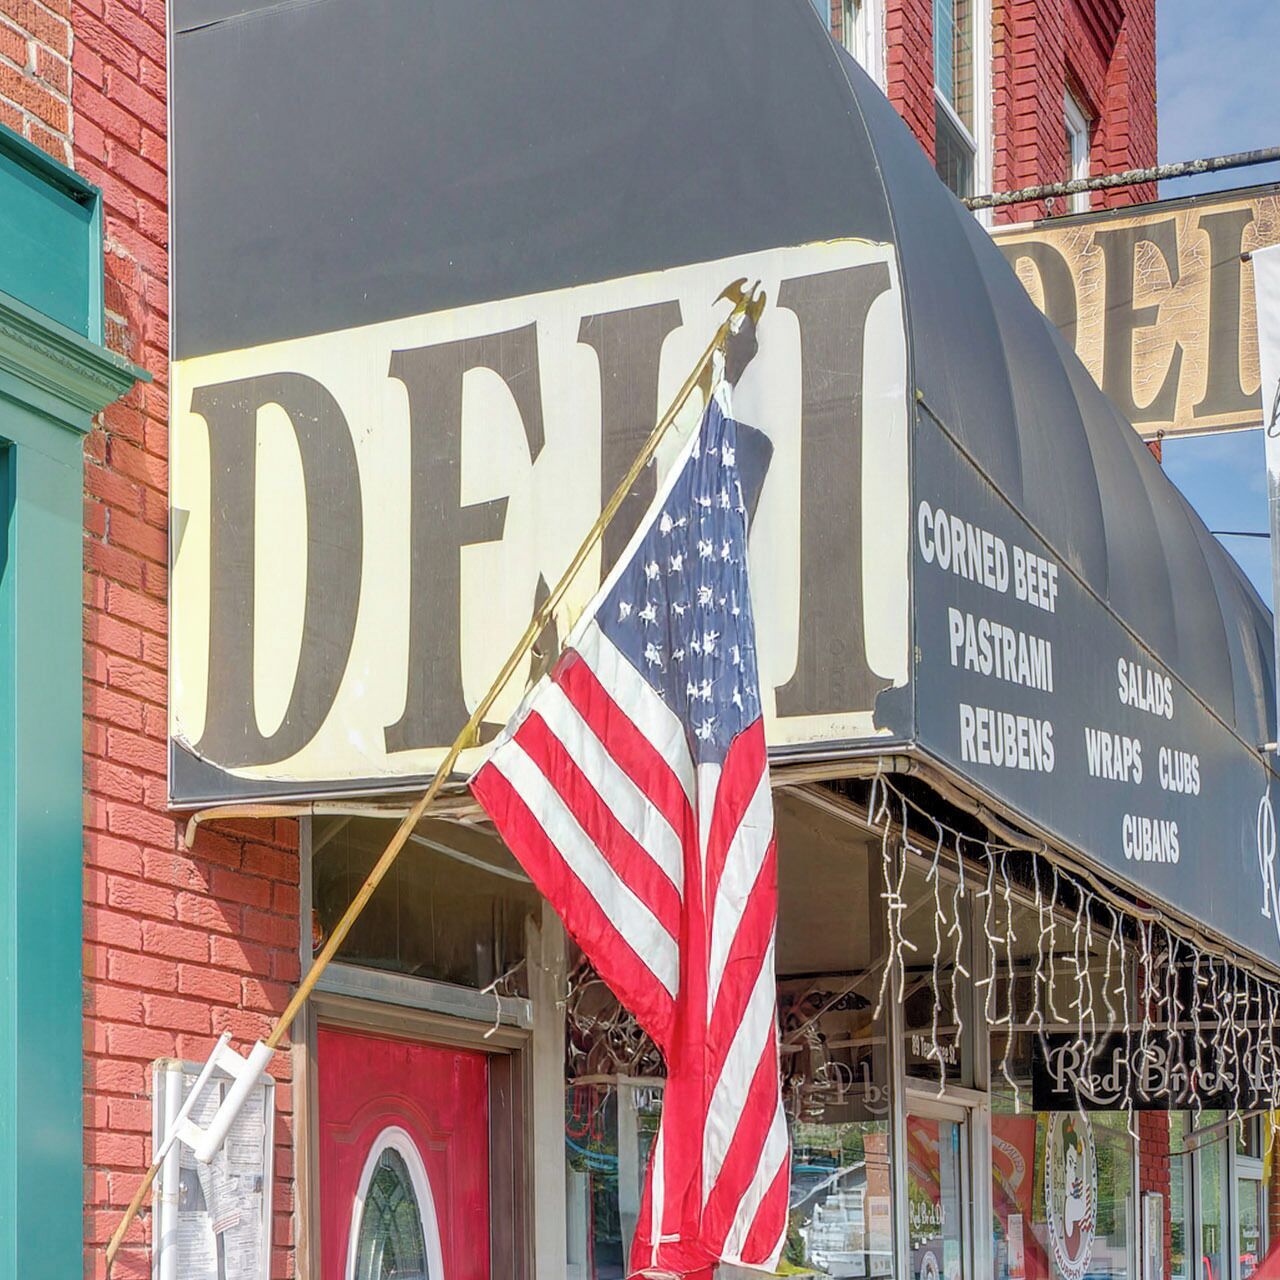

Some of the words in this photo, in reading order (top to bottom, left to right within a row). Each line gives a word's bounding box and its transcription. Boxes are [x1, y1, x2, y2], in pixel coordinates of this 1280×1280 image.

[918, 500, 1010, 594] CORNED
[1013, 544, 1058, 614] BEEF
[948, 606, 1054, 693] PASTRAMI
[1117, 657, 1174, 721] SALADS
[959, 702, 1056, 774] REUBENS
[1084, 727, 1143, 785] WRAPS
[1158, 746, 1201, 796] CLUBS
[1122, 813, 1180, 864] CUBANS
[920, 1036, 949, 1063] Tennsee
[1049, 1040, 1123, 1106] Red
[1132, 1039, 1235, 1093] Brick
